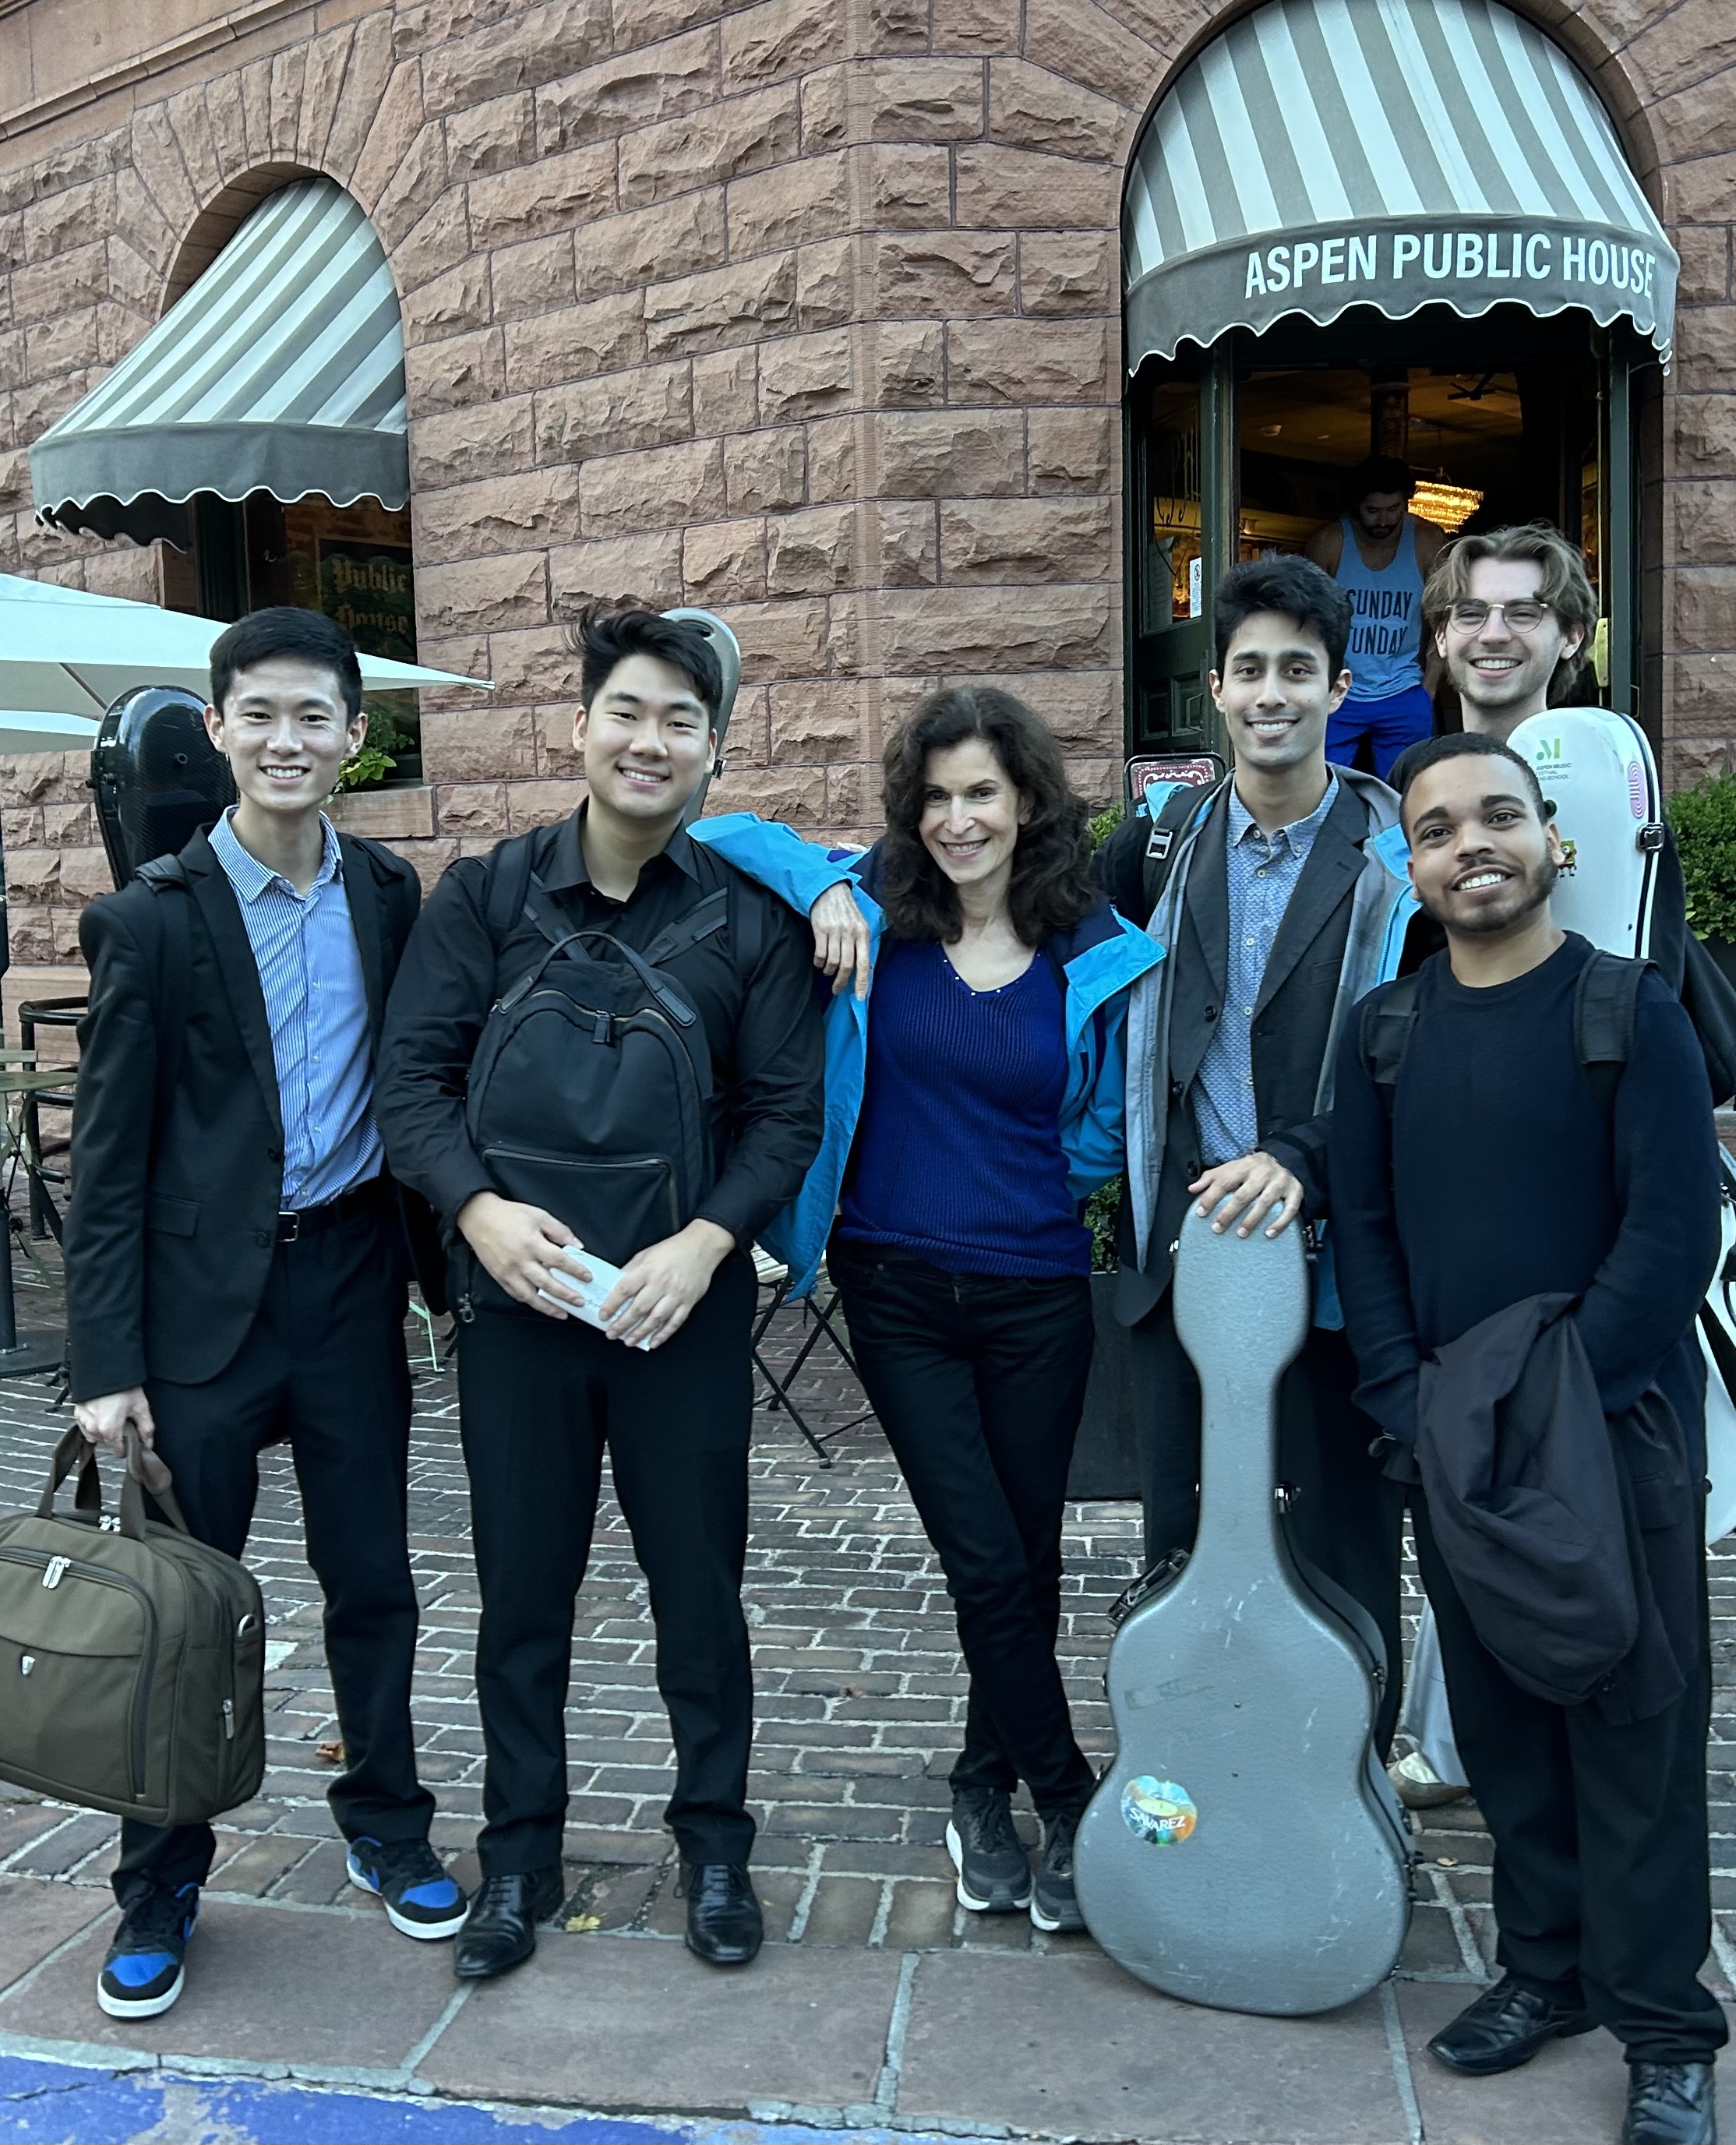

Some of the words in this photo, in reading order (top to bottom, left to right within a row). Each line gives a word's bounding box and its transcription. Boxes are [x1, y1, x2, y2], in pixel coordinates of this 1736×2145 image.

[1244, 234, 1378, 300] ASPEN
[1392, 232, 1551, 280] PUBLIC
[1561, 235, 1657, 299] HOUSE
[330, 558, 408, 594] Public
[1349, 624, 1409, 655] UNDAY
[1130, 1806, 1186, 1833] SAVAREZ
